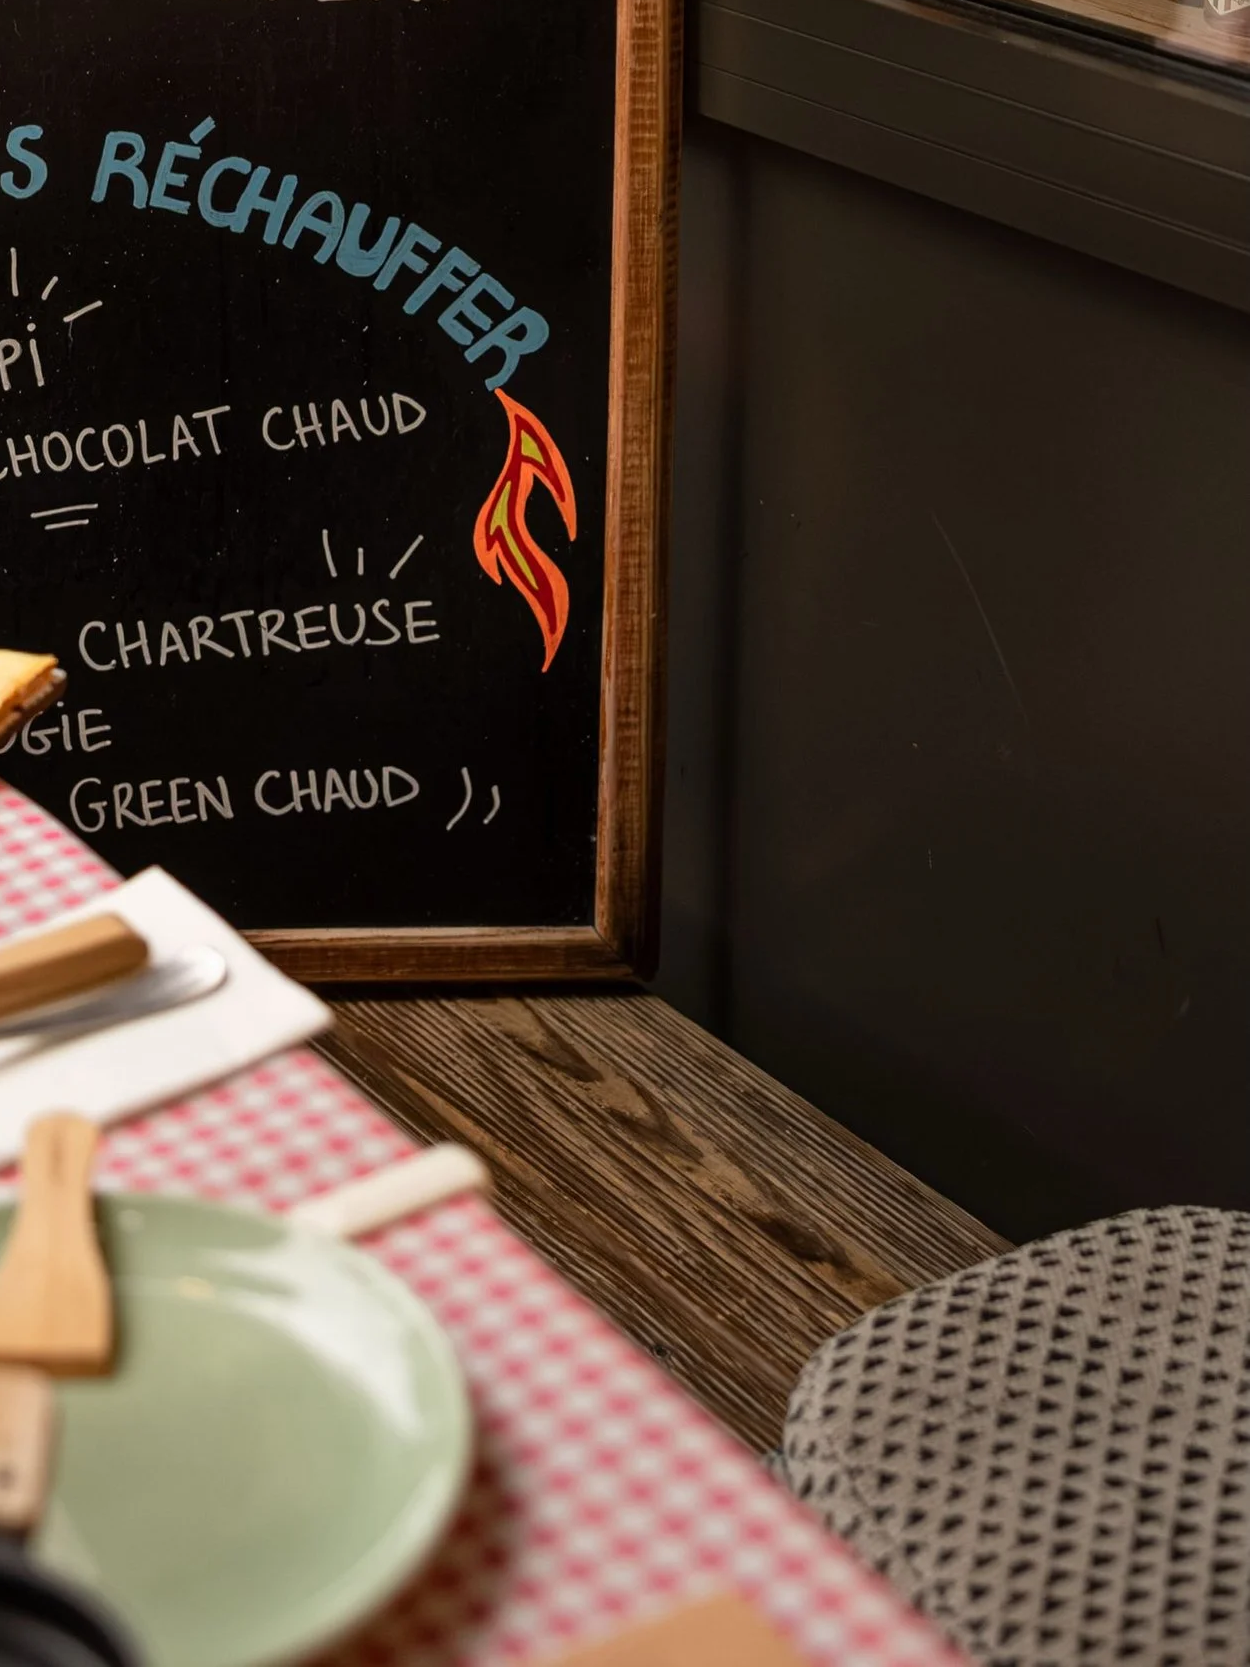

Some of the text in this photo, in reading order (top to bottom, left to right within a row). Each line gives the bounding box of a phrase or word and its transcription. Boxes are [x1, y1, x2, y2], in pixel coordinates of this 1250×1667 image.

[90, 117, 549, 392] RÉCHAUFFER
[262, 392, 427, 451] CHAUD
[78, 598, 440, 672] CHARTREUSE
[69, 766, 420, 834] GREEN CHAUD
